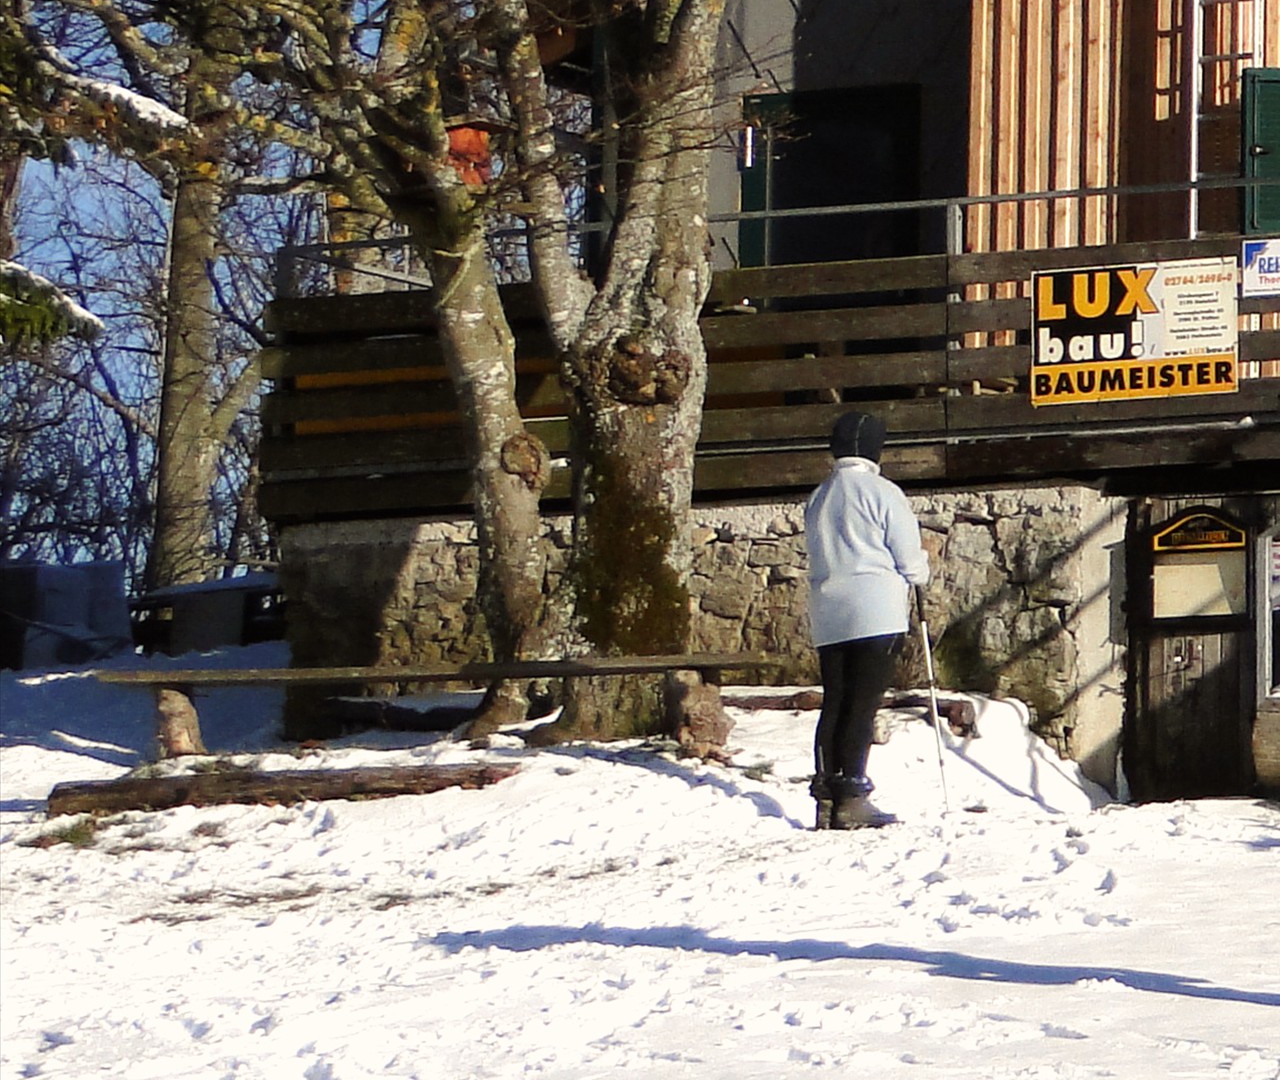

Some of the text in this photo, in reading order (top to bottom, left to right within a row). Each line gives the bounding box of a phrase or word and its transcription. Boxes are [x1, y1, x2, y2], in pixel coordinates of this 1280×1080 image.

[1038, 267, 1160, 320] LUX
[1038, 320, 1145, 363] bau!
[1035, 361, 1234, 397] BAUMEISTER
